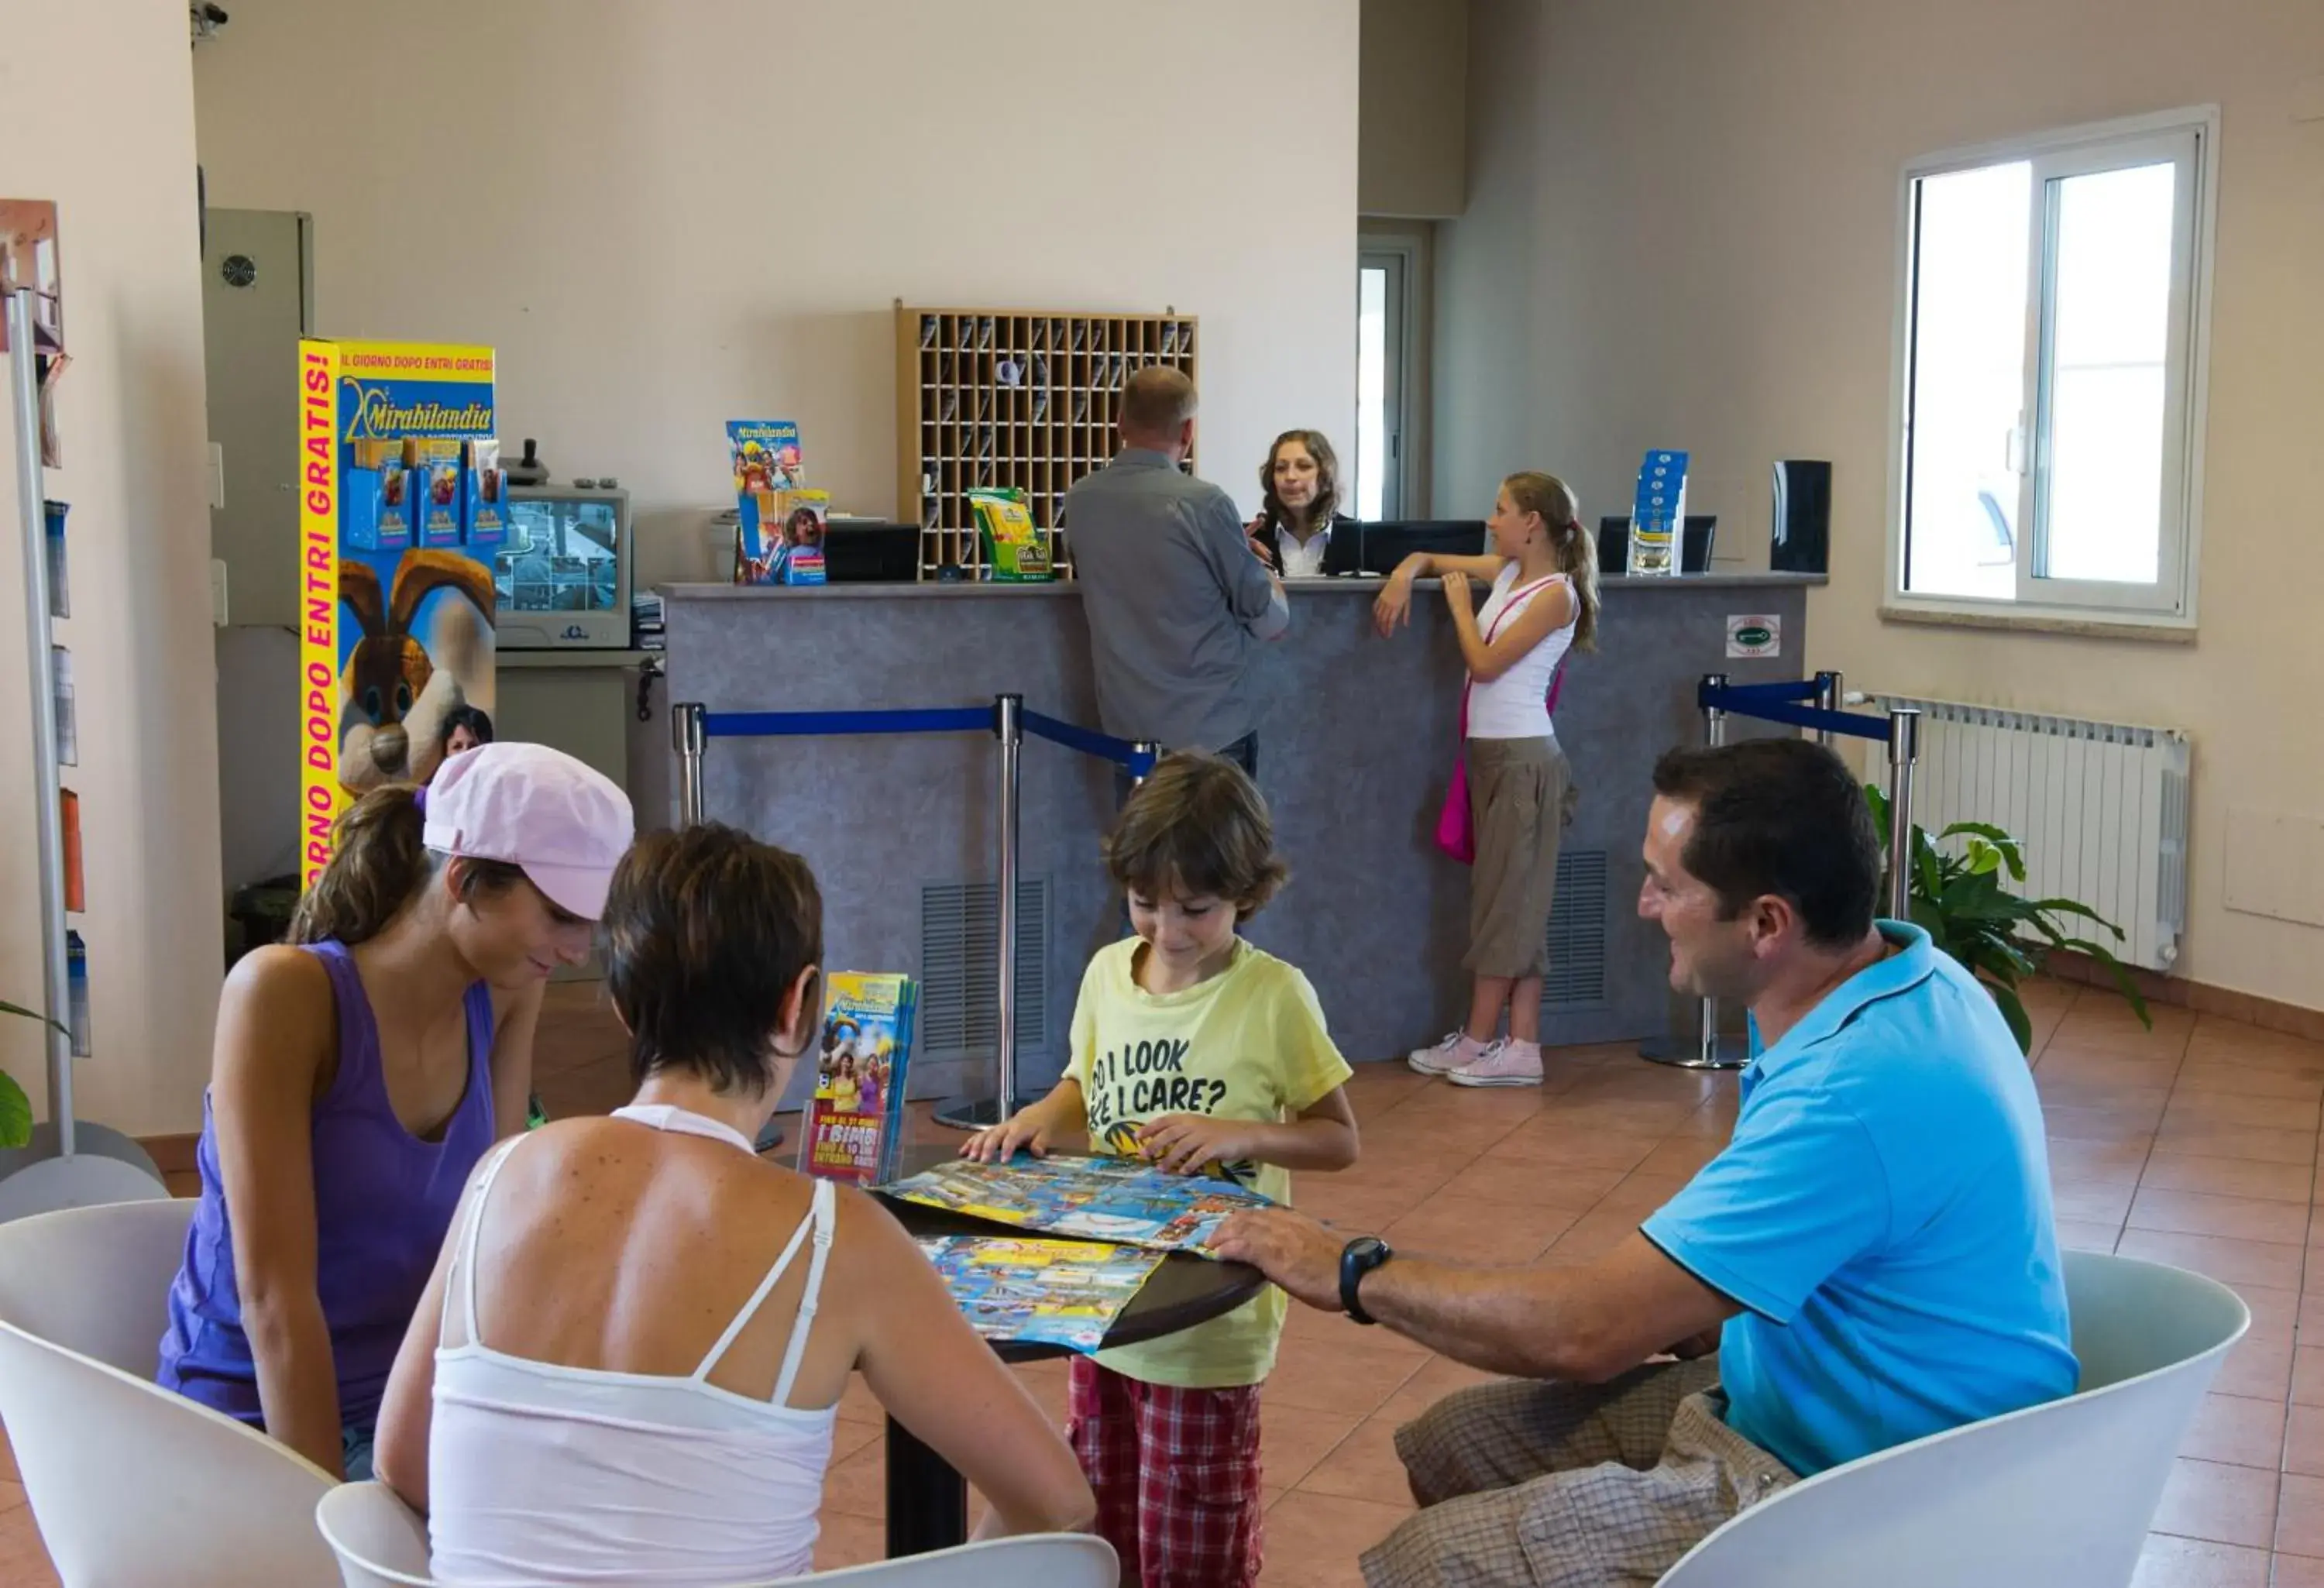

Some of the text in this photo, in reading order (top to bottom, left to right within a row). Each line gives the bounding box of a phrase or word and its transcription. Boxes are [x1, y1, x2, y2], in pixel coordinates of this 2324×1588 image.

[341, 353, 350, 365] IL
[352, 354, 390, 366] GIORNO
[394, 356, 422, 369] DOPO
[425, 357, 452, 370] ENTRI
[306, 354, 332, 515] GRATIS!
[369, 402, 492, 431] Mirabilandia
[307, 531, 332, 648] ENTRI
[307, 662, 332, 771] DOPO
[1108, 1050, 1116, 1082] I
[1124, 1039, 1190, 1077] LOOK
[1118, 1085, 1126, 1116] I
[1133, 1077, 1226, 1115] CARE?
